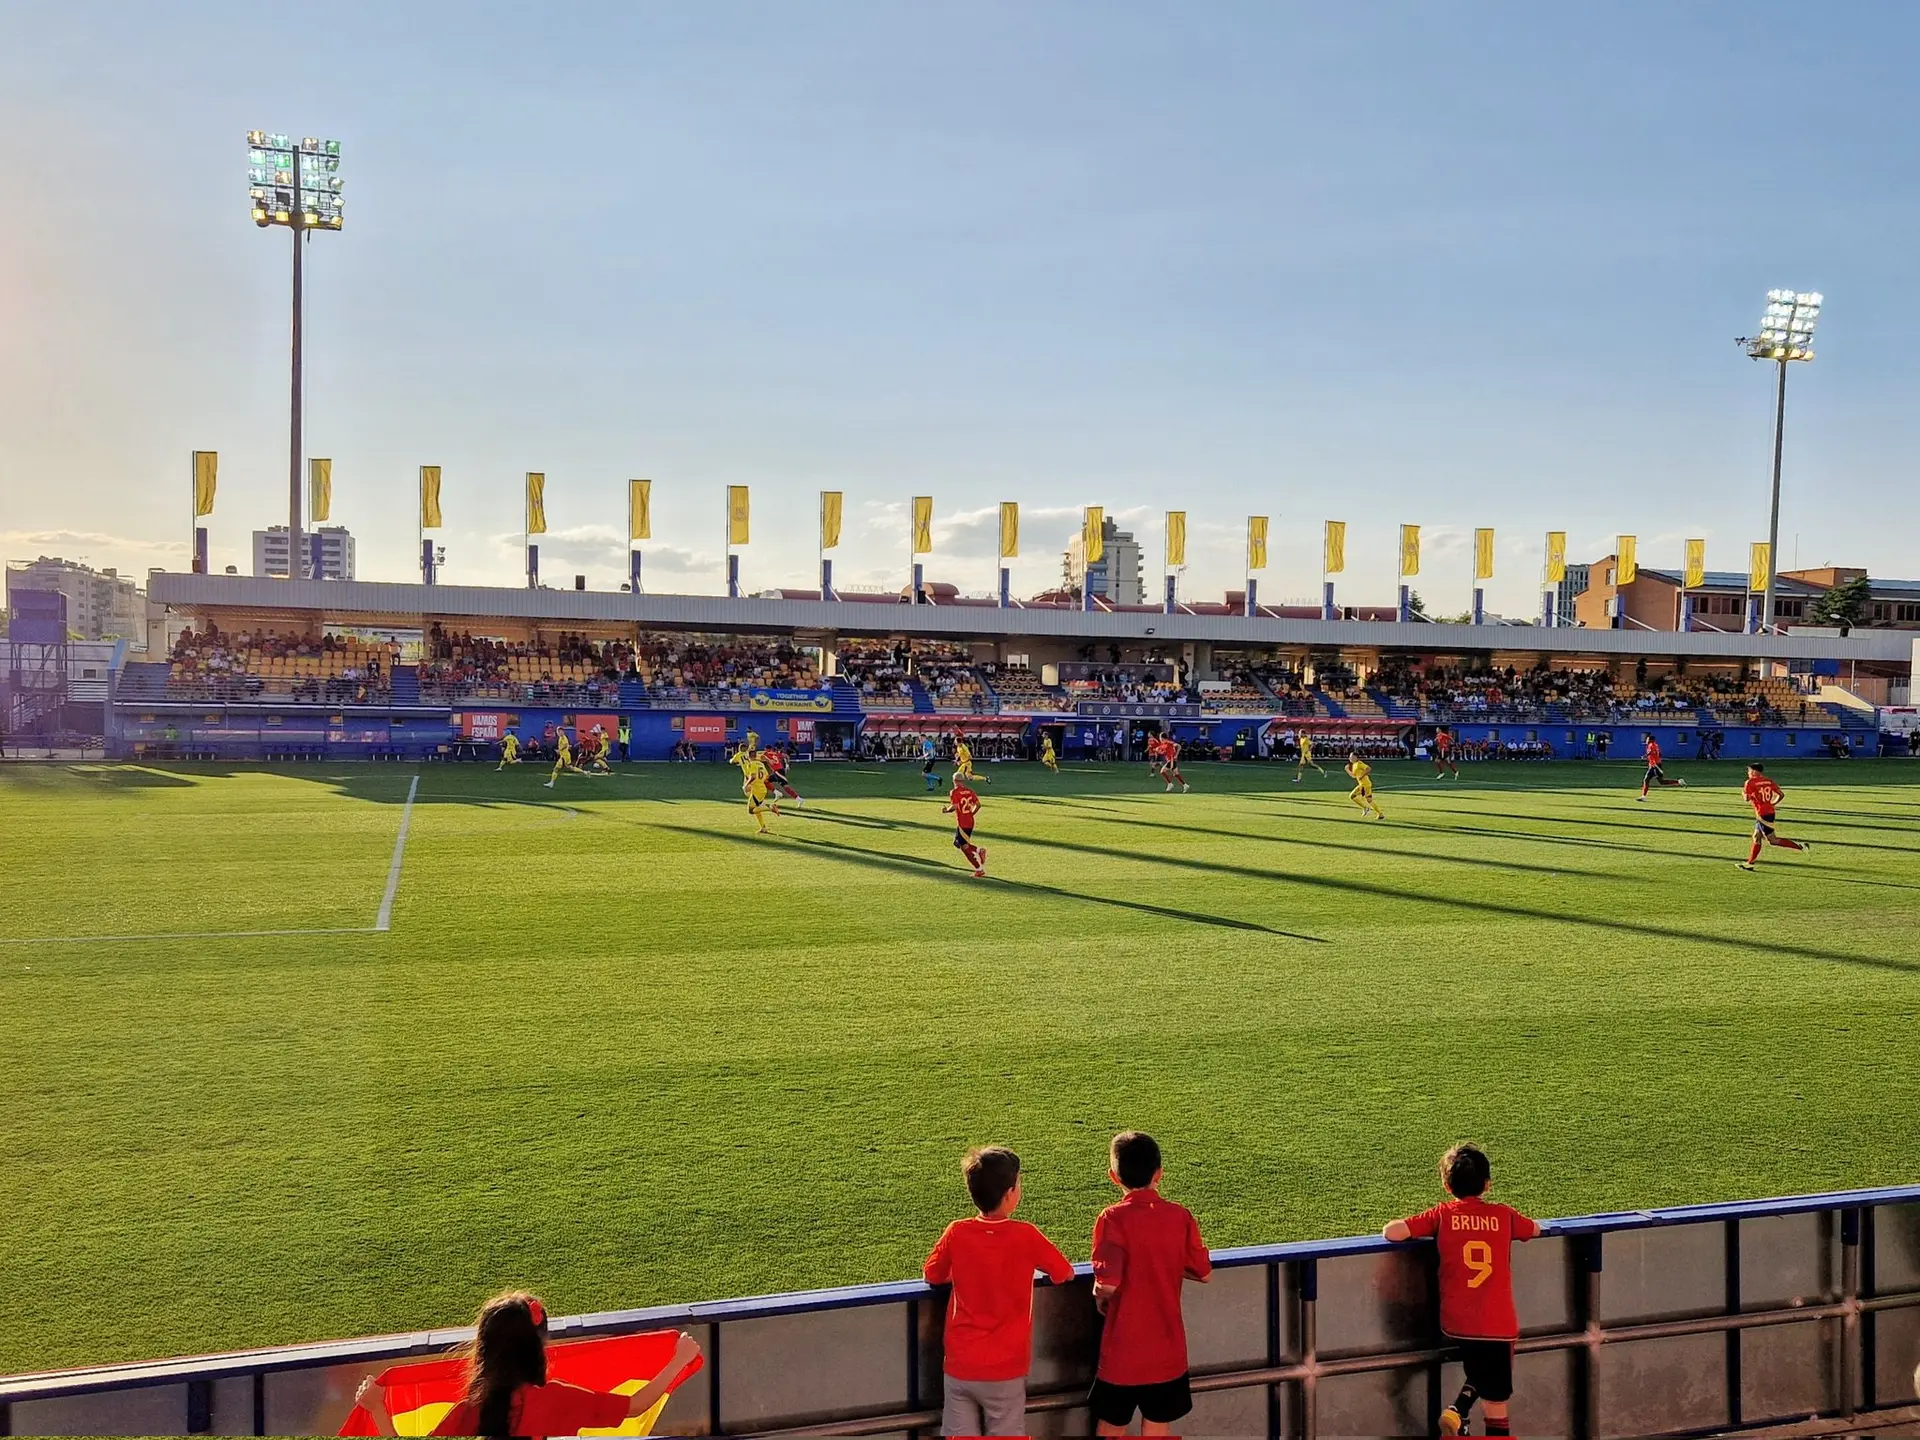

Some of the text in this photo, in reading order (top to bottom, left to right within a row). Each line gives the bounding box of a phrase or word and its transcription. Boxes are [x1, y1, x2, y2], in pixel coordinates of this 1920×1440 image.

[472, 715, 498, 726] VAMOS
[471, 726, 498, 737] ESPAÑA
[1759, 787, 1771, 802] 18
[1451, 1215, 1499, 1232] BRUNO
[1463, 1240, 1492, 1288] 9
